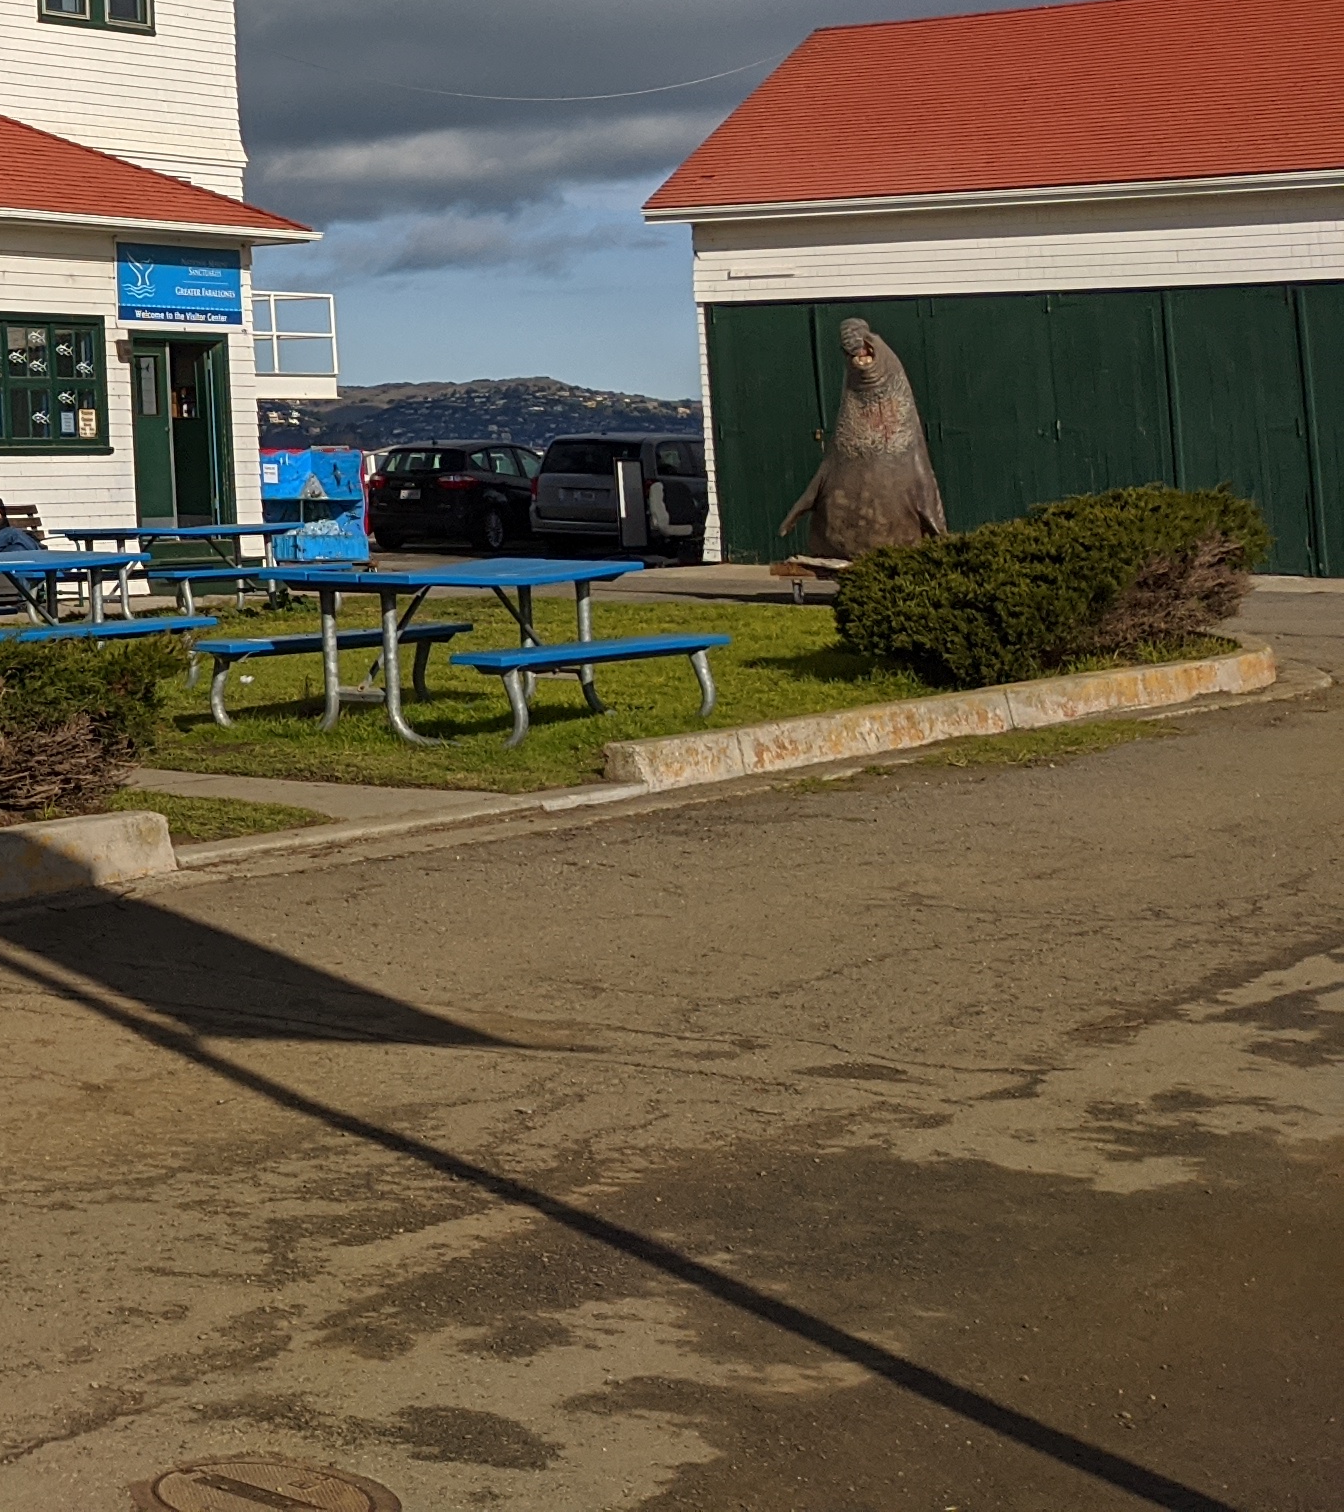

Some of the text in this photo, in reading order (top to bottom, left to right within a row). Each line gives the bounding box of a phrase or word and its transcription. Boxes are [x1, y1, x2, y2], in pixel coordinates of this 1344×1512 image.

[175, 286, 201, 296] GREATER
[134, 309, 228, 322] Welcome to the Visitor Center
